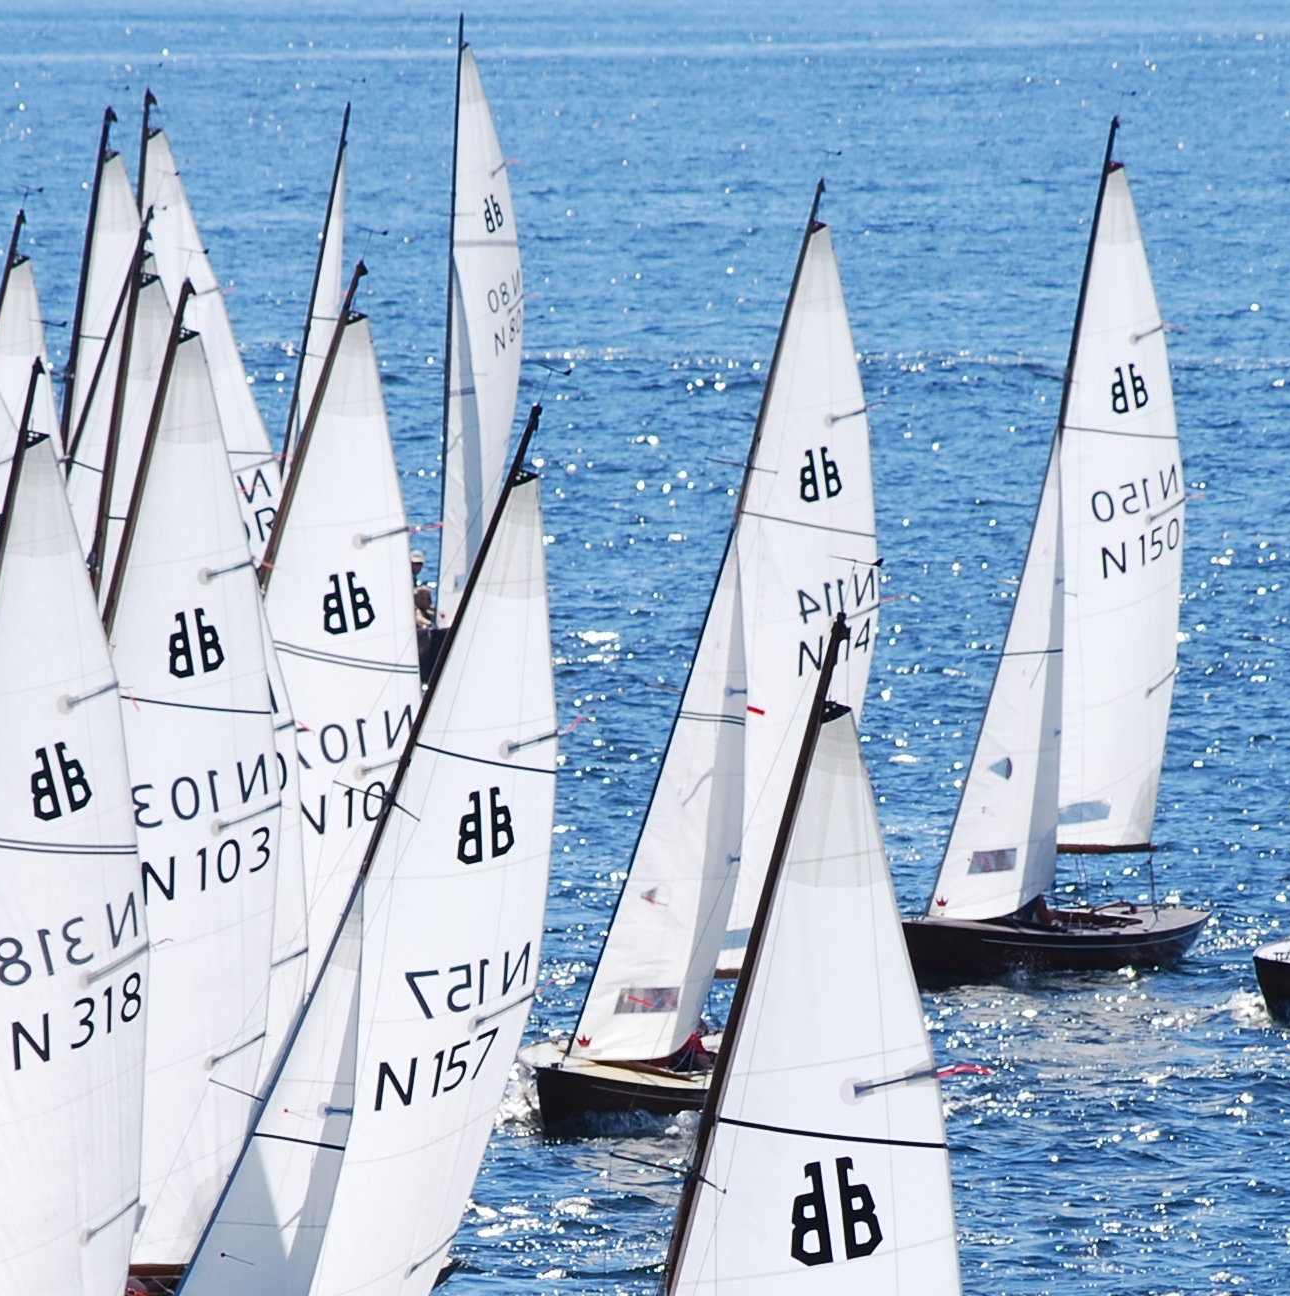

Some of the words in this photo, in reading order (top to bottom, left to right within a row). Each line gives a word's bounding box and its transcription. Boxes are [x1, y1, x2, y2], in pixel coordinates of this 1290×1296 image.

[494, 326, 506, 357] N
[1101, 541, 1127, 579] N
[1138, 518, 1180, 567] 150
[798, 635, 824, 677] N
[141, 855, 175, 906] N
[196, 826, 271, 892] 103
[11, 1012, 51, 1071] N
[69, 970, 143, 1051] 318
[373, 1057, 419, 1112] N
[430, 1026, 501, 1099] 157
